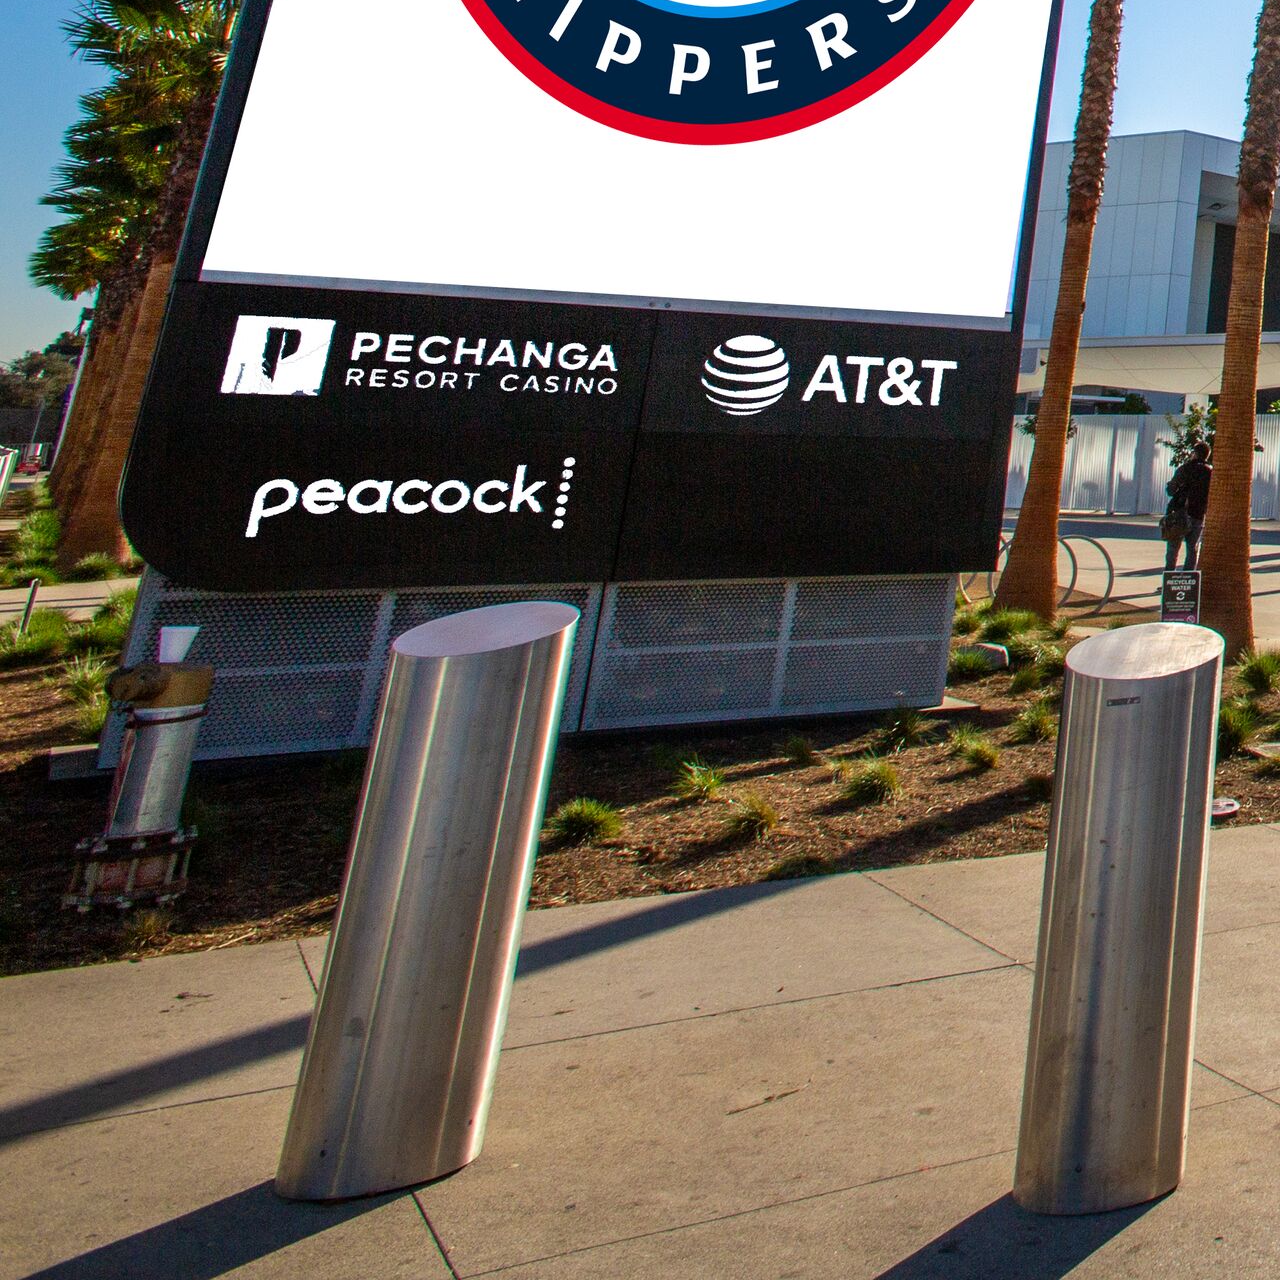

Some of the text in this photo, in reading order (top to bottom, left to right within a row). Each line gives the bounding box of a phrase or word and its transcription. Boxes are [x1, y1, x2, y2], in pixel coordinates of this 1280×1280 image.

[350, 331, 619, 372] PECHANGA
[345, 367, 618, 395] RESORT CASINO
[801, 354, 958, 407] AT&T
[246, 464, 547, 538] peacock
